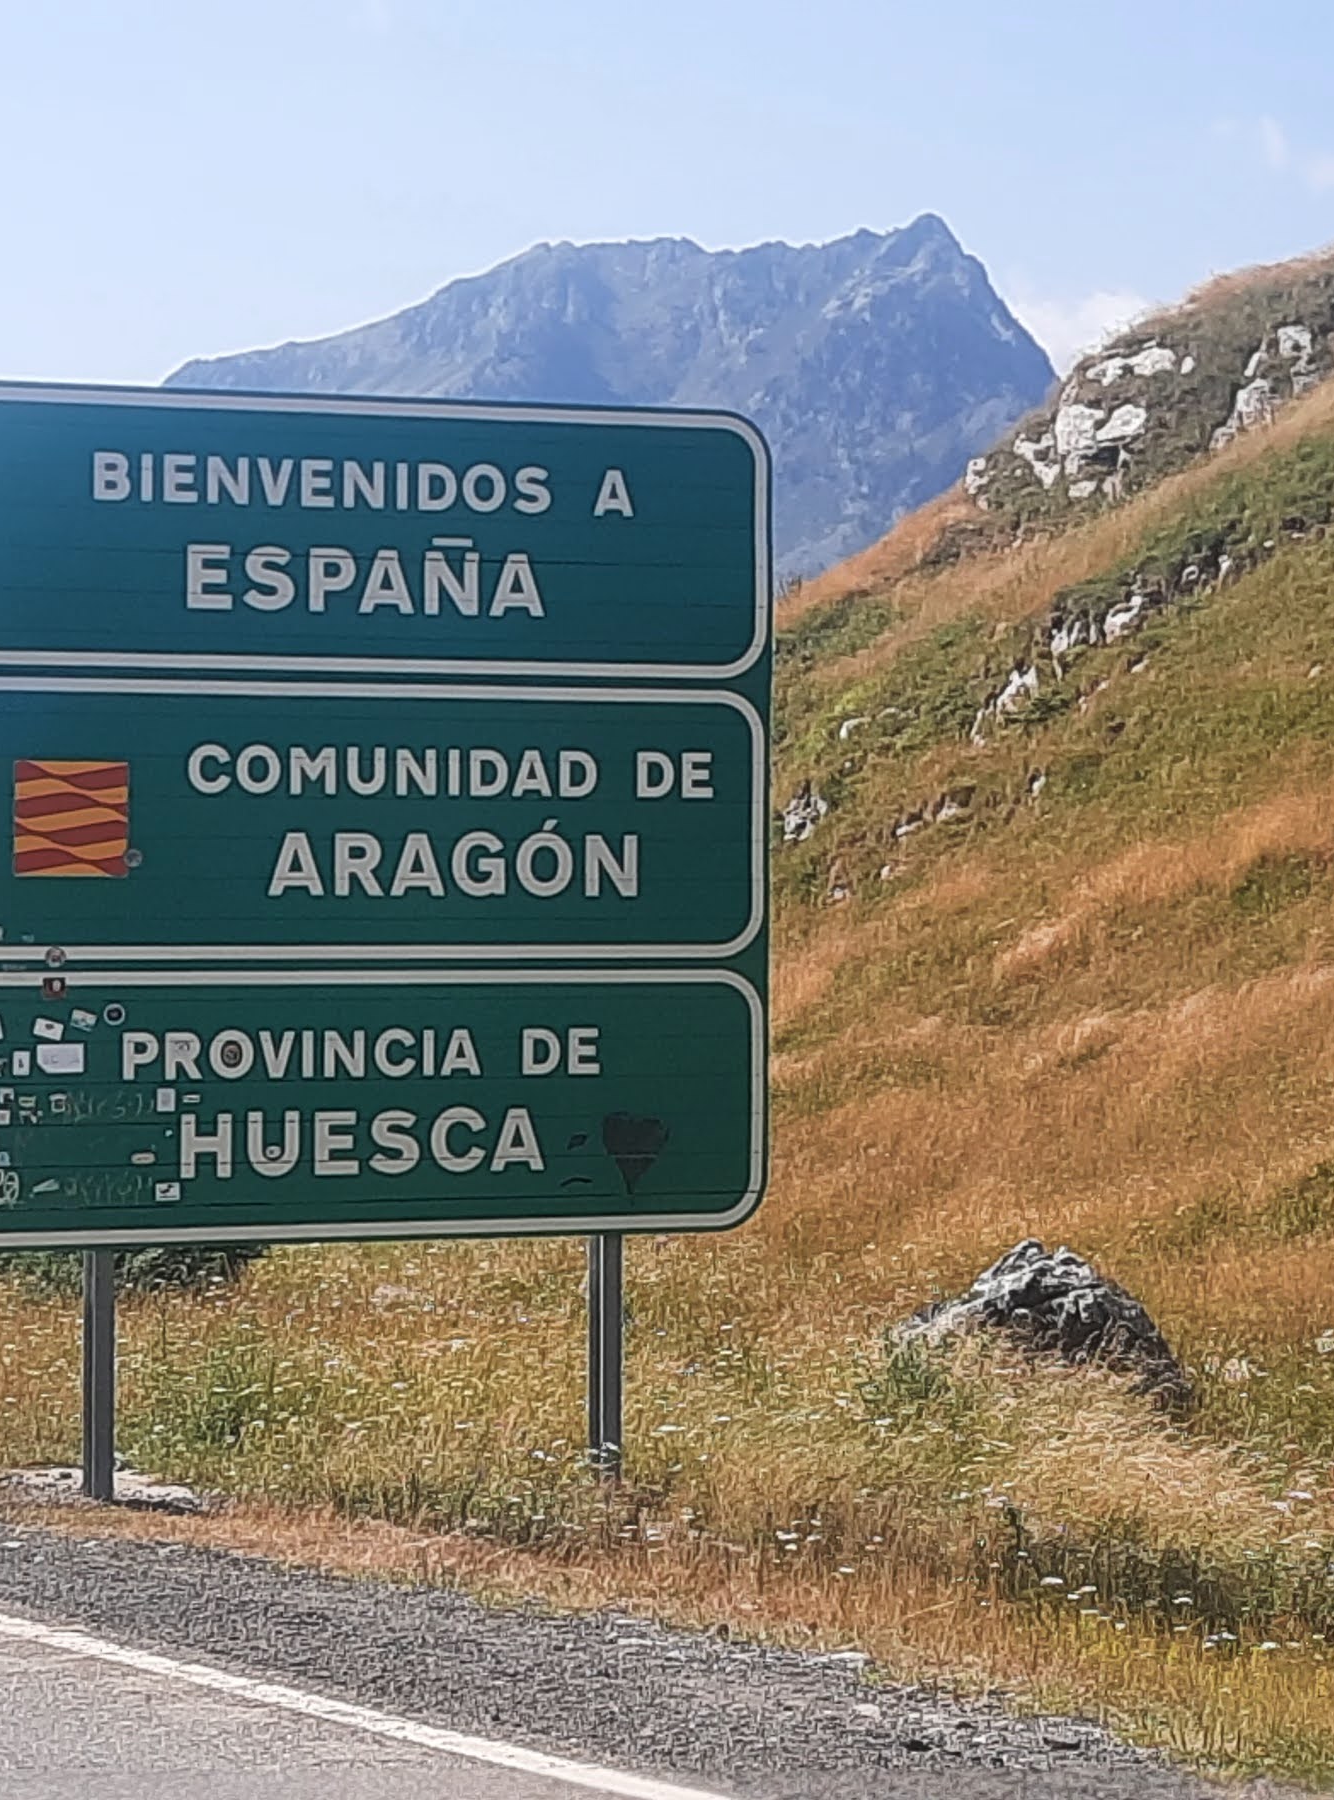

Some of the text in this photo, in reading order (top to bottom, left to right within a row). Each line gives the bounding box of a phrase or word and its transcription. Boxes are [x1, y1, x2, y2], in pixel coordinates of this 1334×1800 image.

[92, 451, 634, 518] BIENVENIDOS A
[186, 537, 545, 618] ESPAÑA
[188, 744, 714, 800] COMUNIDAD DE
[268, 820, 639, 898] ARAGÓN
[122, 1027, 601, 1080] PROVINCIA DE
[180, 1108, 545, 1179] HUESCA
